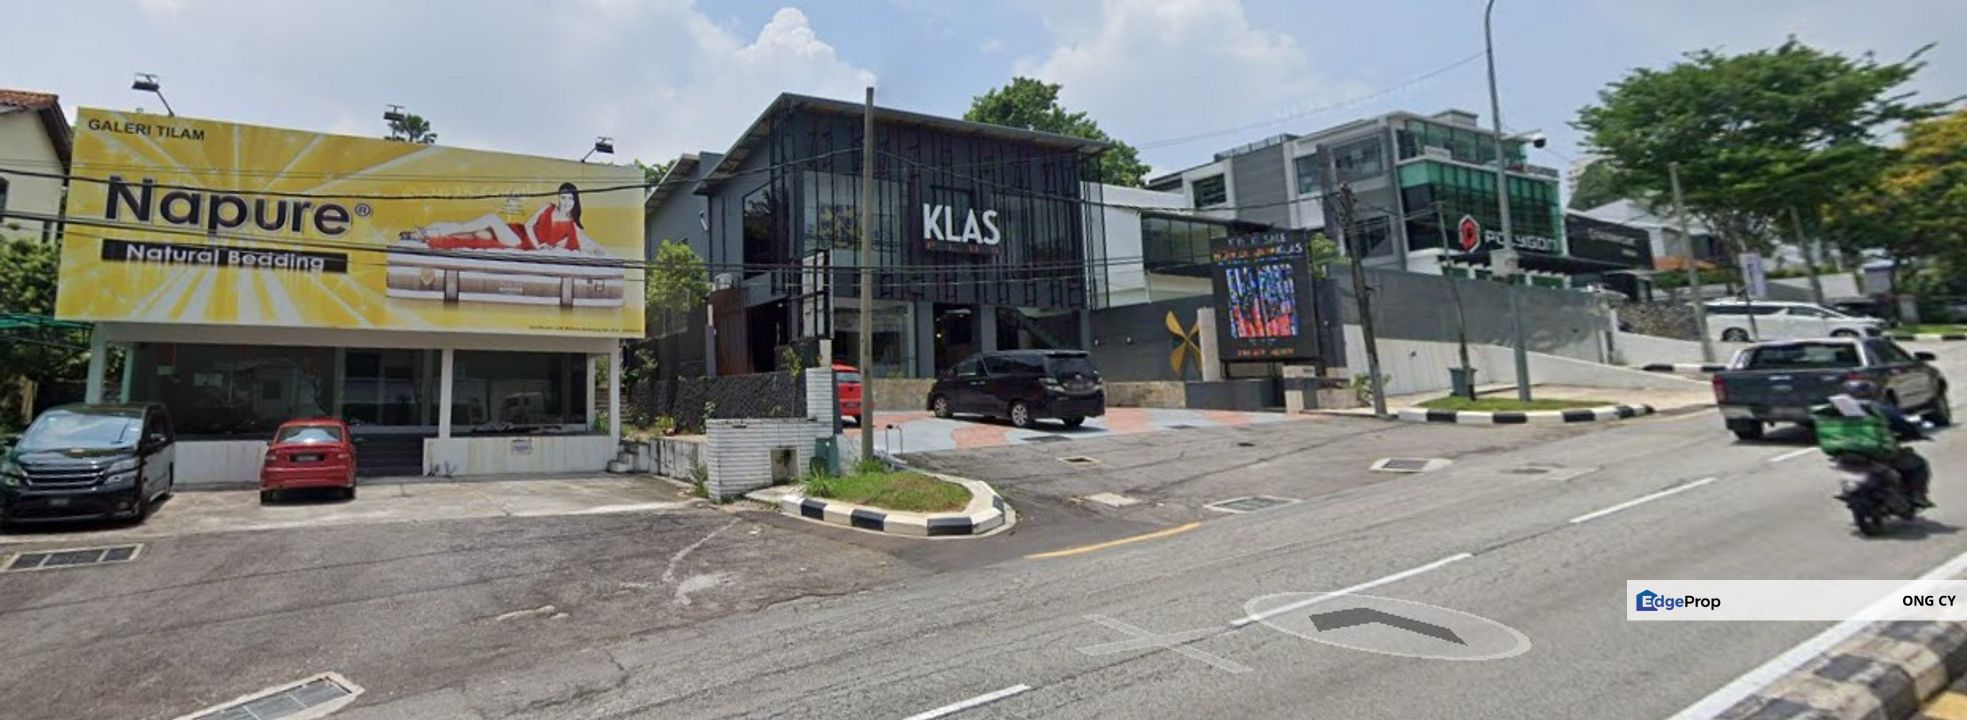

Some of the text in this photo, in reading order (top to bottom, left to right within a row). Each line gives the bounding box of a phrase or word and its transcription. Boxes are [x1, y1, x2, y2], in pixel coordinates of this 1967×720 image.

[88, 118, 205, 141] GALERI TILAM
[923, 203, 1000, 245] KLAS
[126, 244, 324, 271] Natural Bedding
